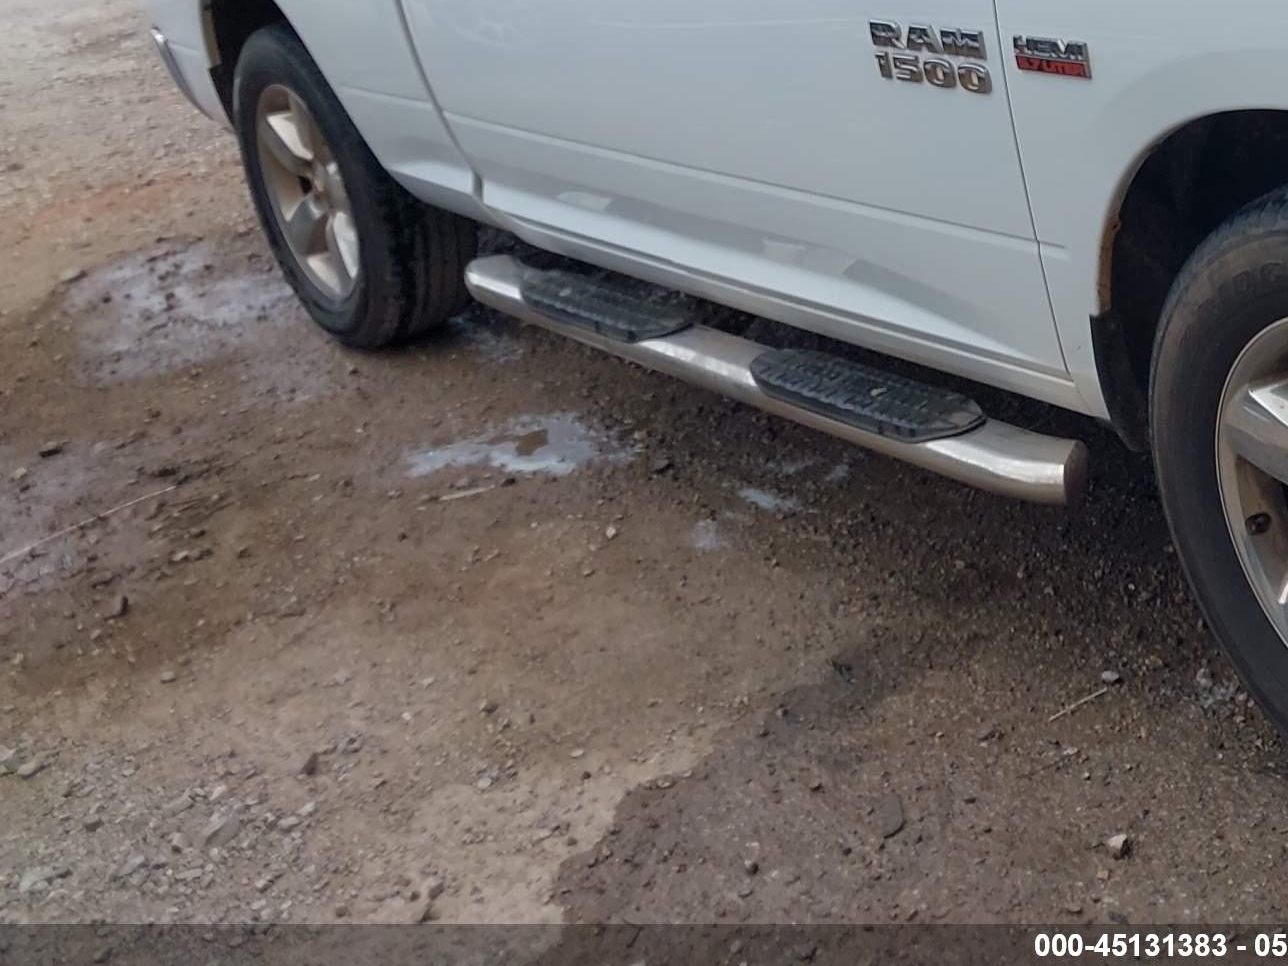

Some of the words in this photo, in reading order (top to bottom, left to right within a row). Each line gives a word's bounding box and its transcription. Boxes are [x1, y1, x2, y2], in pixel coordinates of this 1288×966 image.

[868, 19, 987, 60] RAM
[1012, 34, 1088, 63] HEMI
[875, 51, 993, 94] 1500
